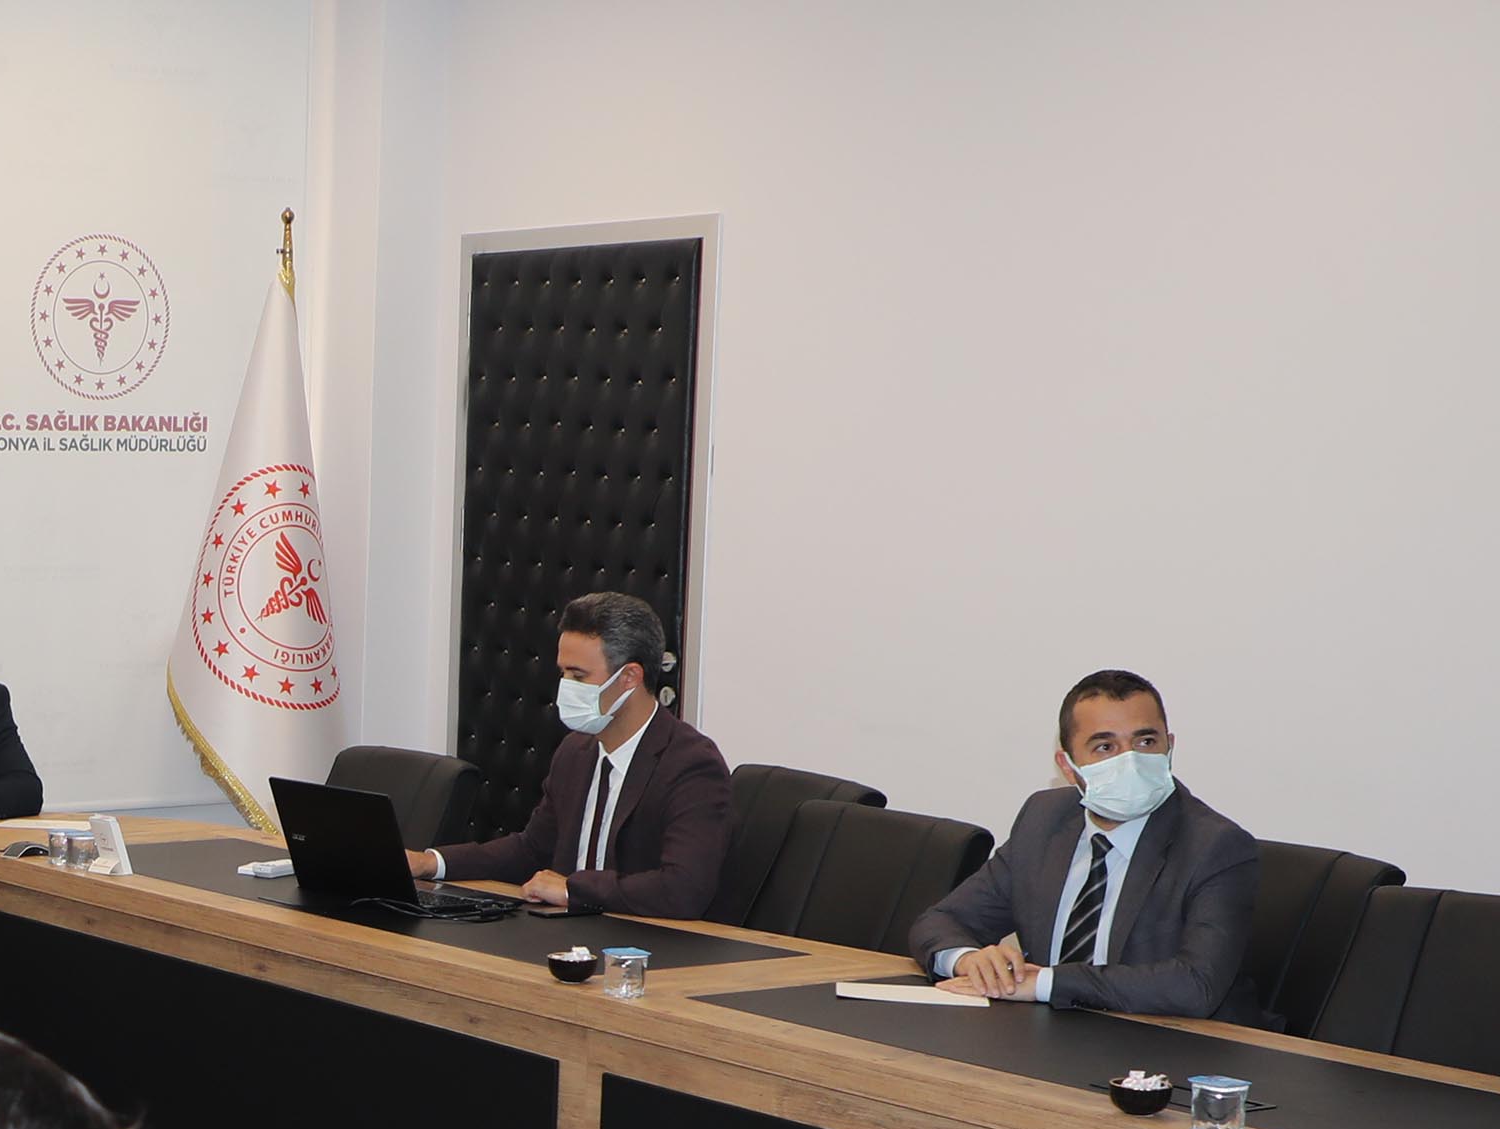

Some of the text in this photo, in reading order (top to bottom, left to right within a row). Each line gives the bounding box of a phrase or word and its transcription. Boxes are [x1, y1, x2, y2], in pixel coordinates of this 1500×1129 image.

[26, 410, 99, 431] SAĞLIK
[104, 412, 207, 432] BAKANLIĞI
[59, 434, 112, 451] SAĞLIK
[116, 435, 207, 452] MÜDÜRLÜĞÜ
[223, 526, 257, 598] TÜRKİYE
